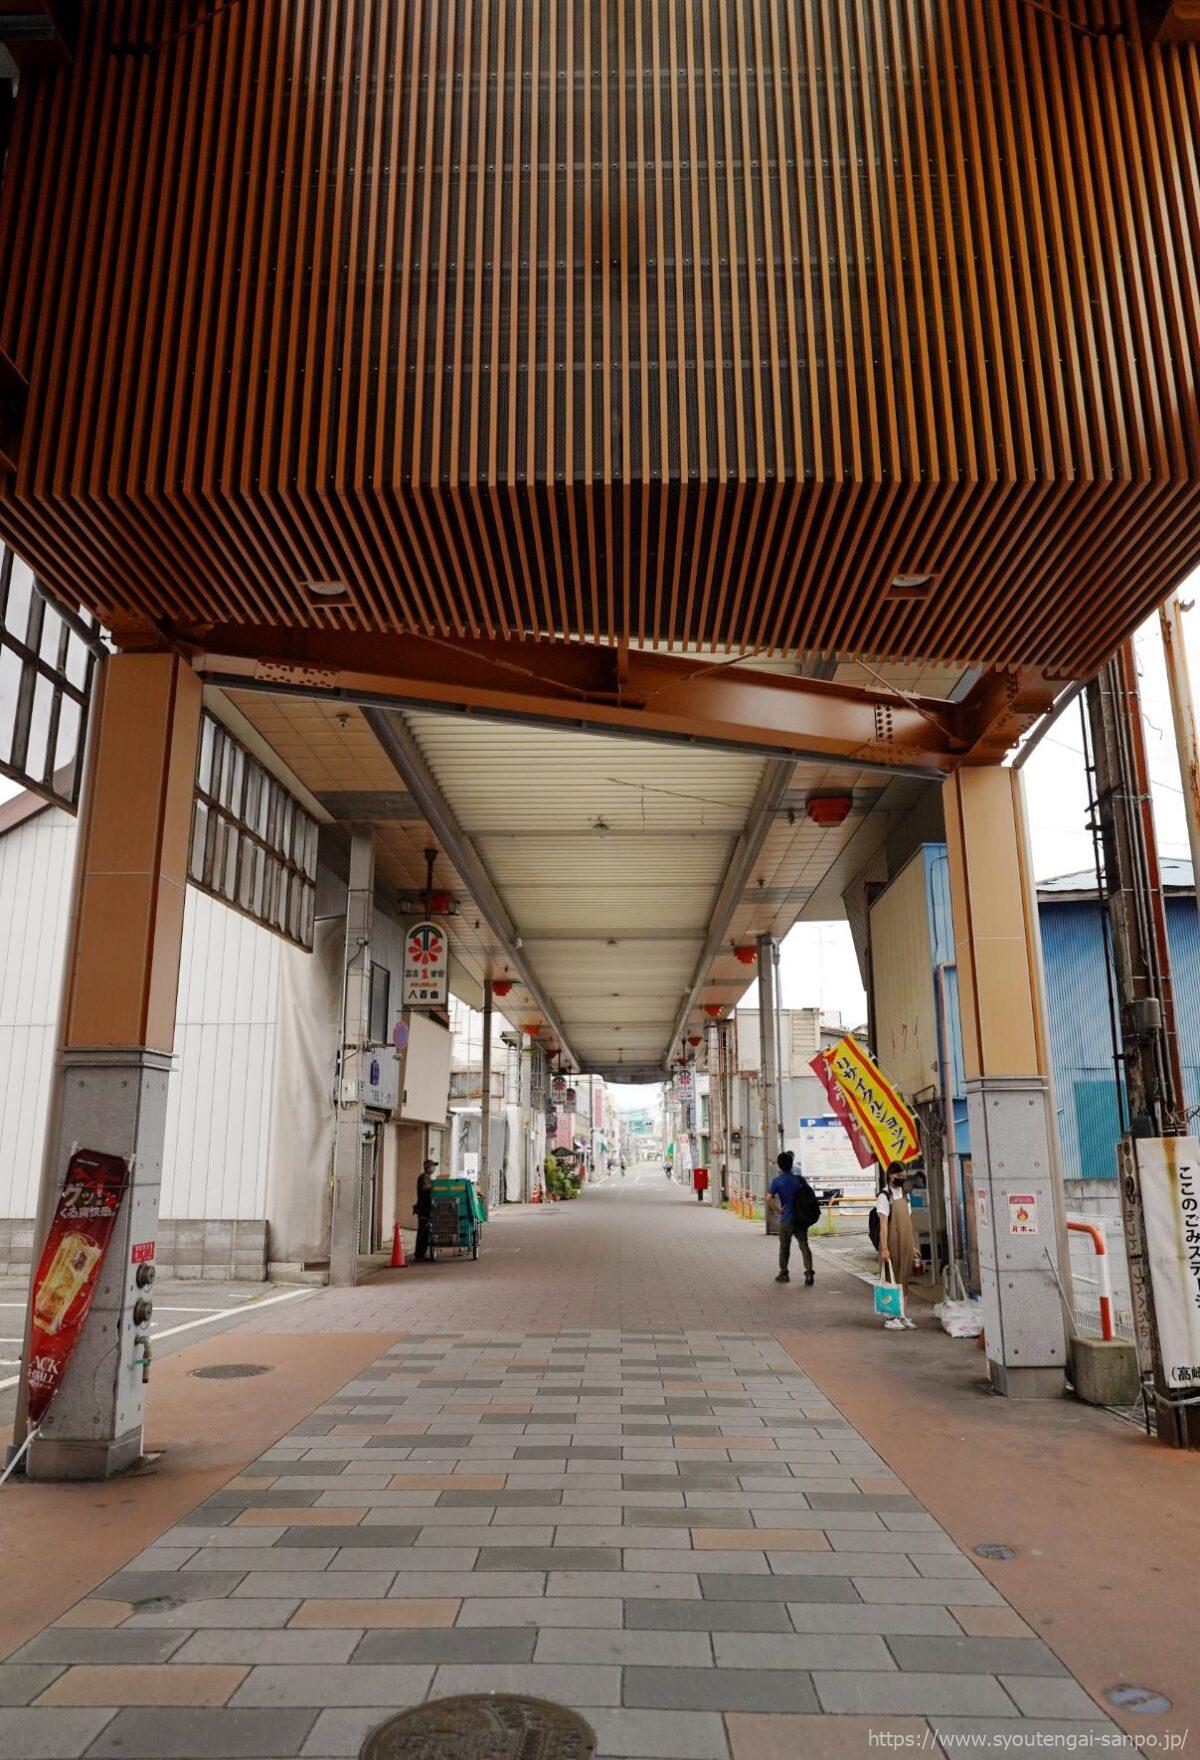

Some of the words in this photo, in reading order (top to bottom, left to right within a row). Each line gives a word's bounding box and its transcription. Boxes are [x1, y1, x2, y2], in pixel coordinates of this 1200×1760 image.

[836, 1056, 907, 1155] リサイクルショップ
